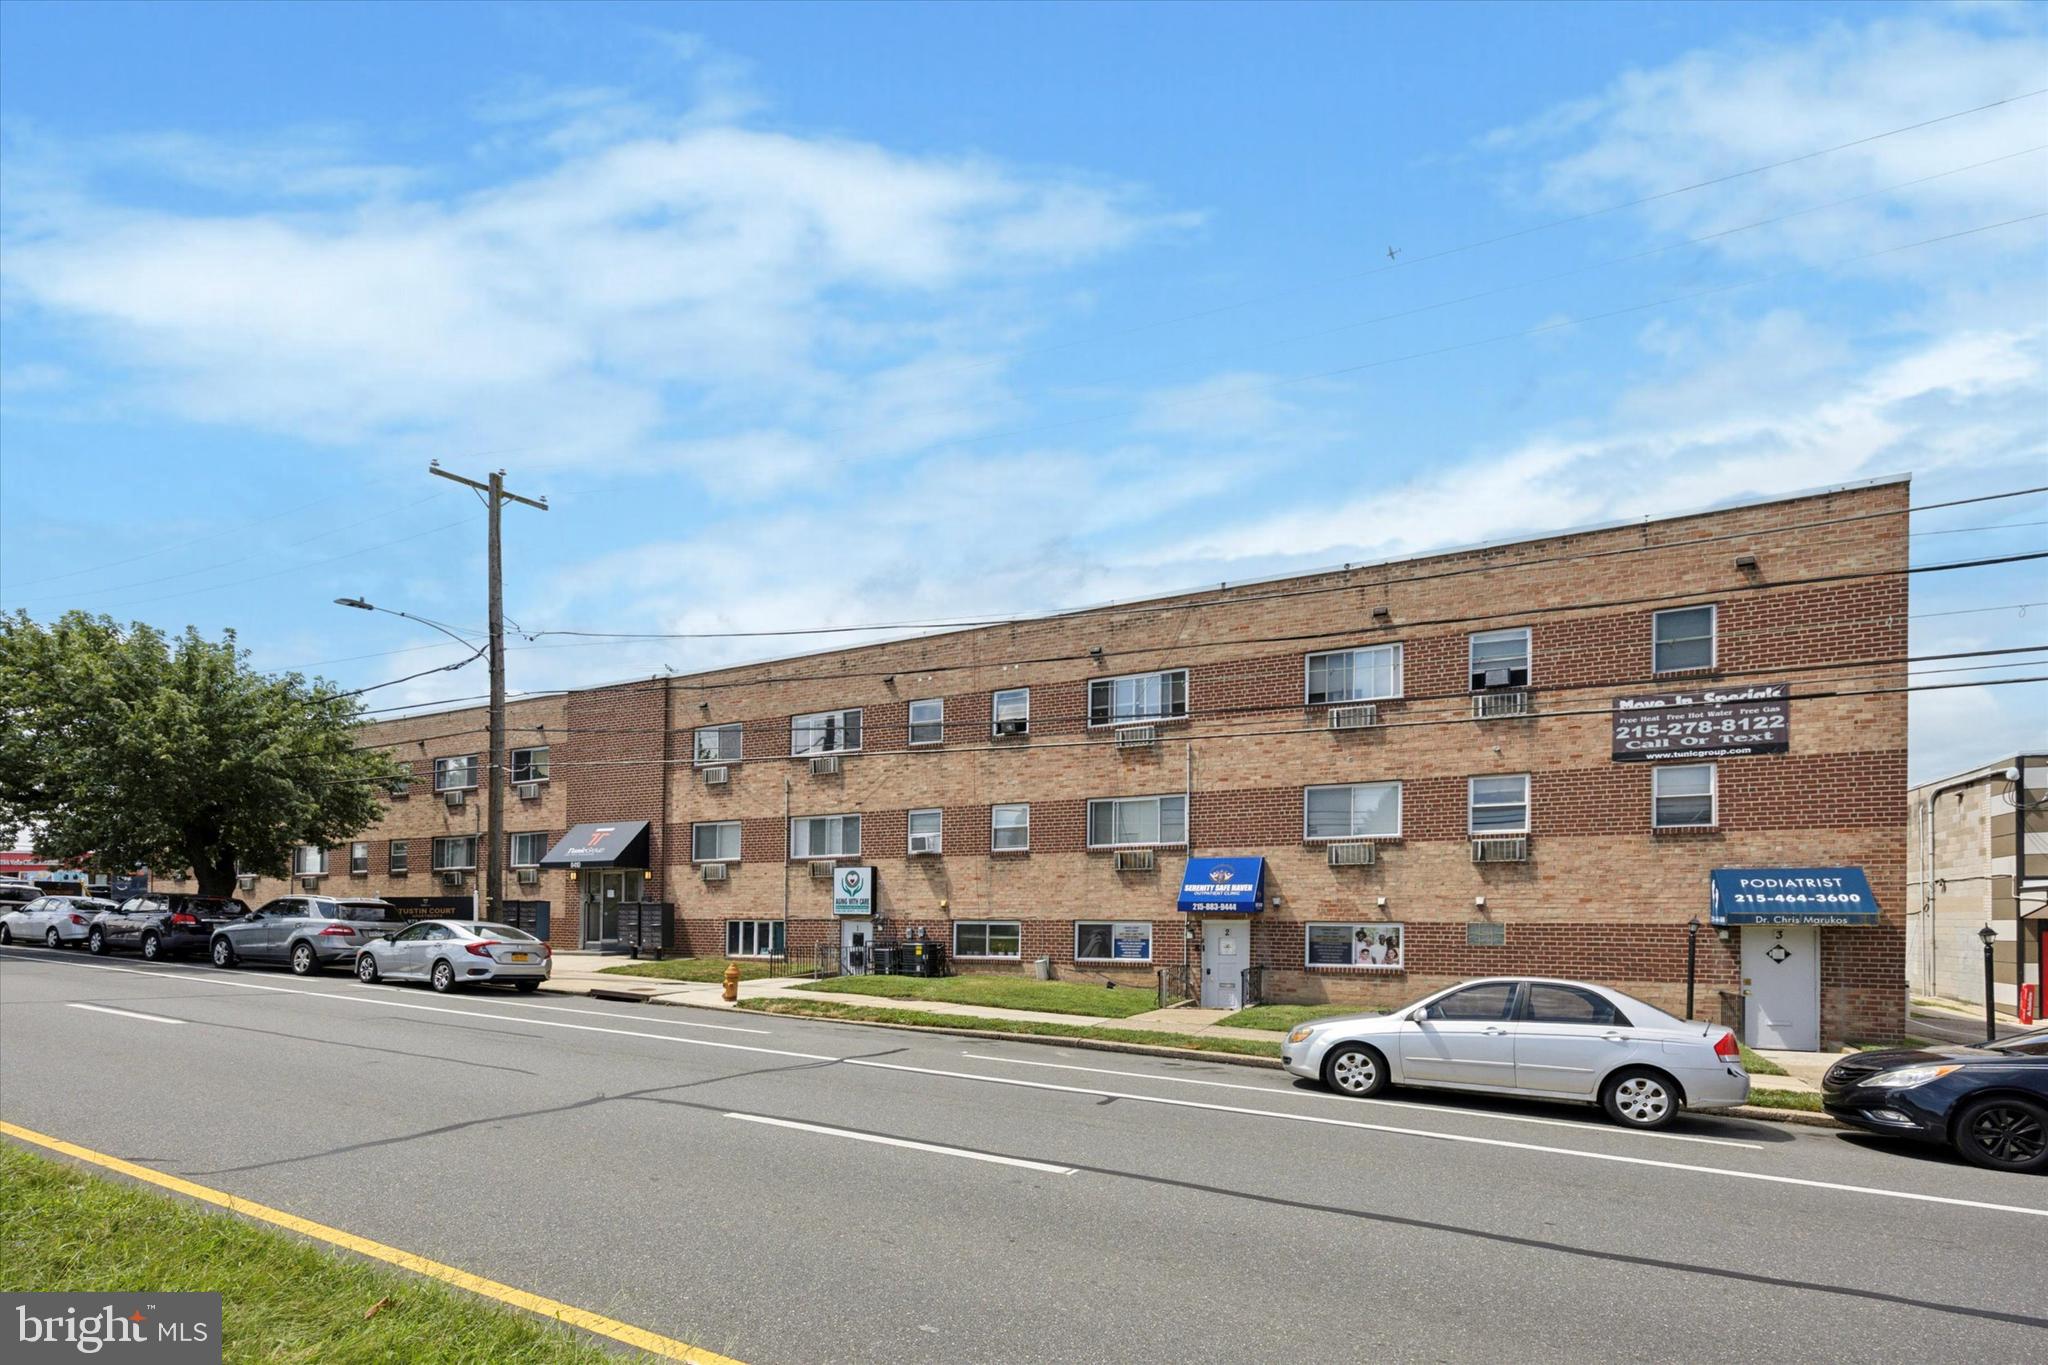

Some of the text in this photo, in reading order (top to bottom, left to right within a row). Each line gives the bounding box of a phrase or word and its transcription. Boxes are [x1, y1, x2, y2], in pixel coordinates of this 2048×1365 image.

[1666, 713, 1686, 721] Free
[1688, 711, 1704, 719] Hot
[1707, 709, 1734, 718] Water
[1739, 706, 1760, 715] Free
[1762, 705, 1781, 713] Gas
[1616, 715, 1785, 739] 215-278-8122
[1625, 731, 1775, 750] Call Or Text
[1646, 747, 1752, 760] www.tunicgroup.com
[1184, 884, 1253, 892] SERENITY SAFE HAVEN
[1740, 878, 1843, 888] PODIATRIST
[1734, 894, 1861, 903] 215-464-3600
[1755, 916, 1848, 924] Dr. Chris Marukos
[1775, 930, 1784, 940] 3
